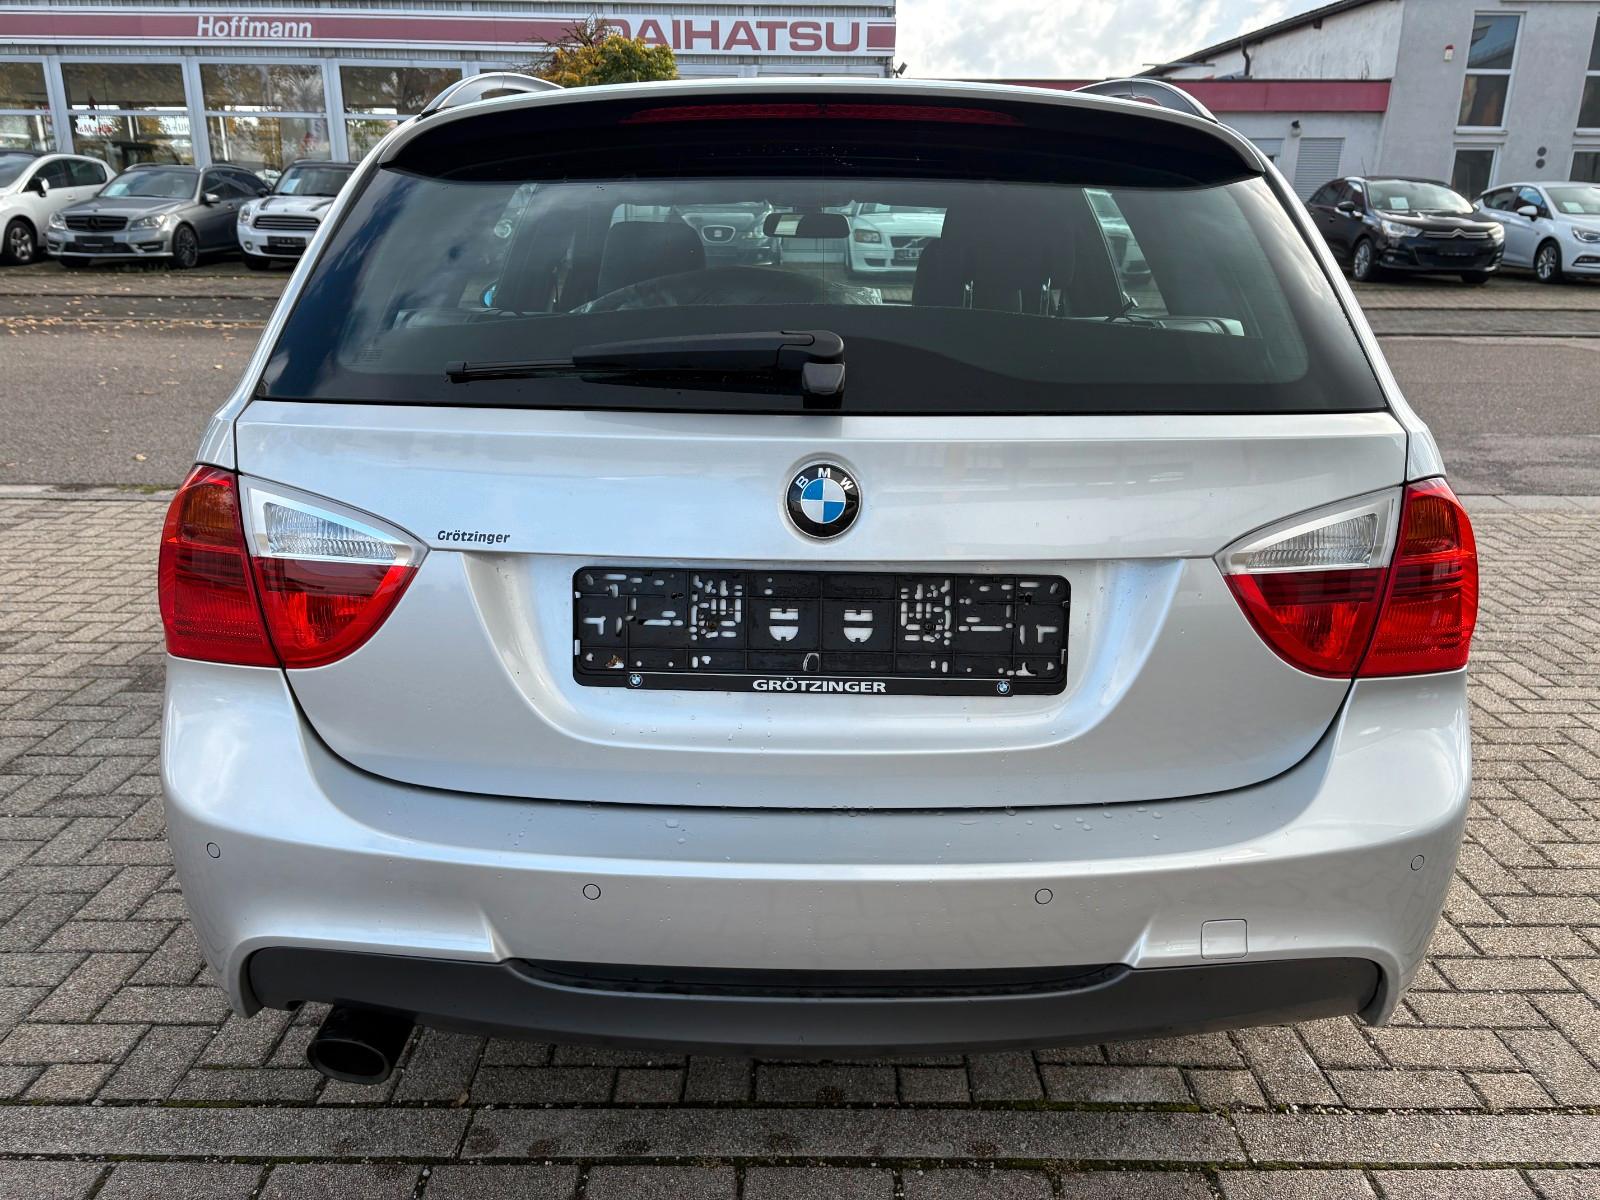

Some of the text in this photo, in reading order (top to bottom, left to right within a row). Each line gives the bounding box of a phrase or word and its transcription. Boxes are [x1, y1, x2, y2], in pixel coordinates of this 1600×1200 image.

[197, 15, 312, 37] Hoffmann
[795, 467, 854, 490] BMW
[437, 529, 511, 544] Grötzinger
[752, 677, 887, 693] GRÖTZINGER
